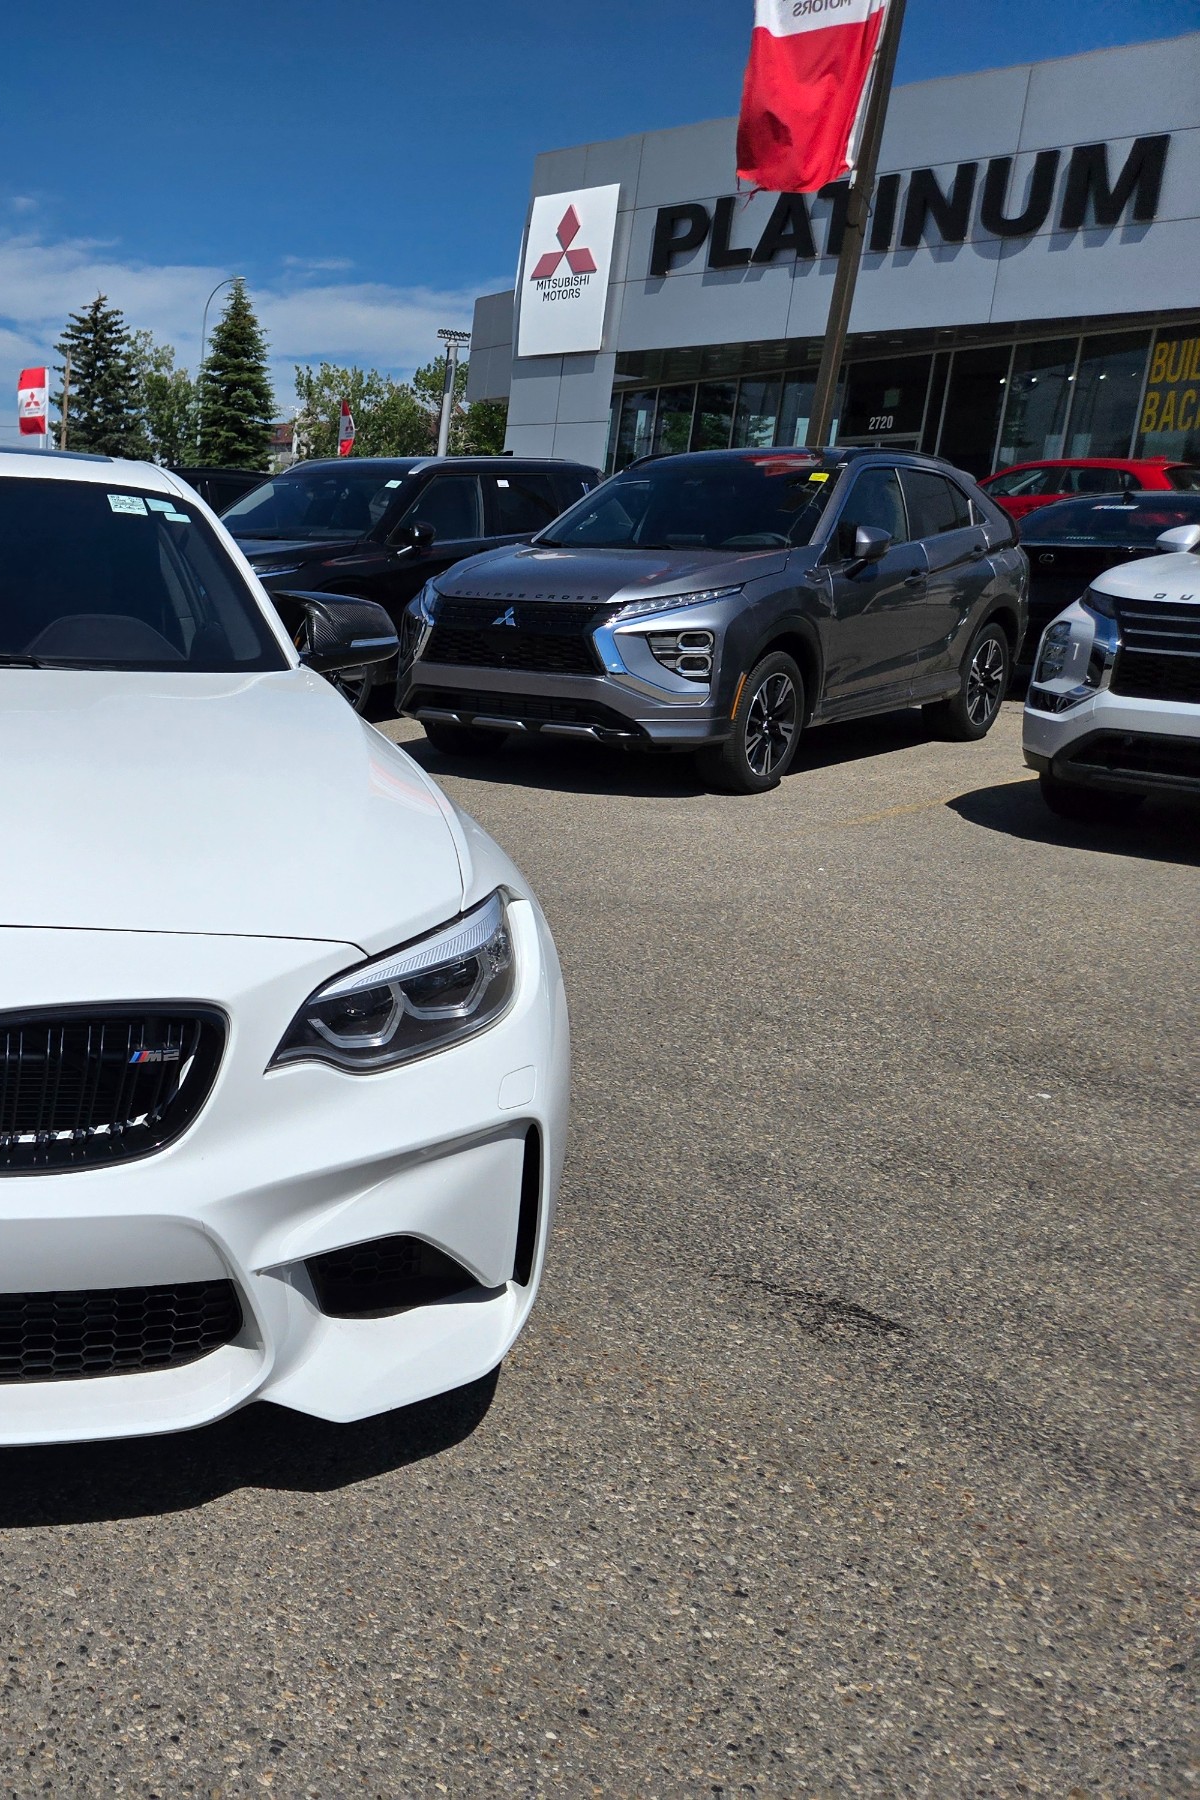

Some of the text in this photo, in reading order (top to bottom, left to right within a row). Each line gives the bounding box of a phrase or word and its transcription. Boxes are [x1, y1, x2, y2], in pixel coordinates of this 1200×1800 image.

[650, 134, 1171, 276] PLATINUM
[536, 275, 590, 291] MITSUBISHI
[542, 288, 581, 302] MOTORS
[868, 415, 894, 430] 2720
[454, 590, 600, 601] ECLIPSE CROSS
